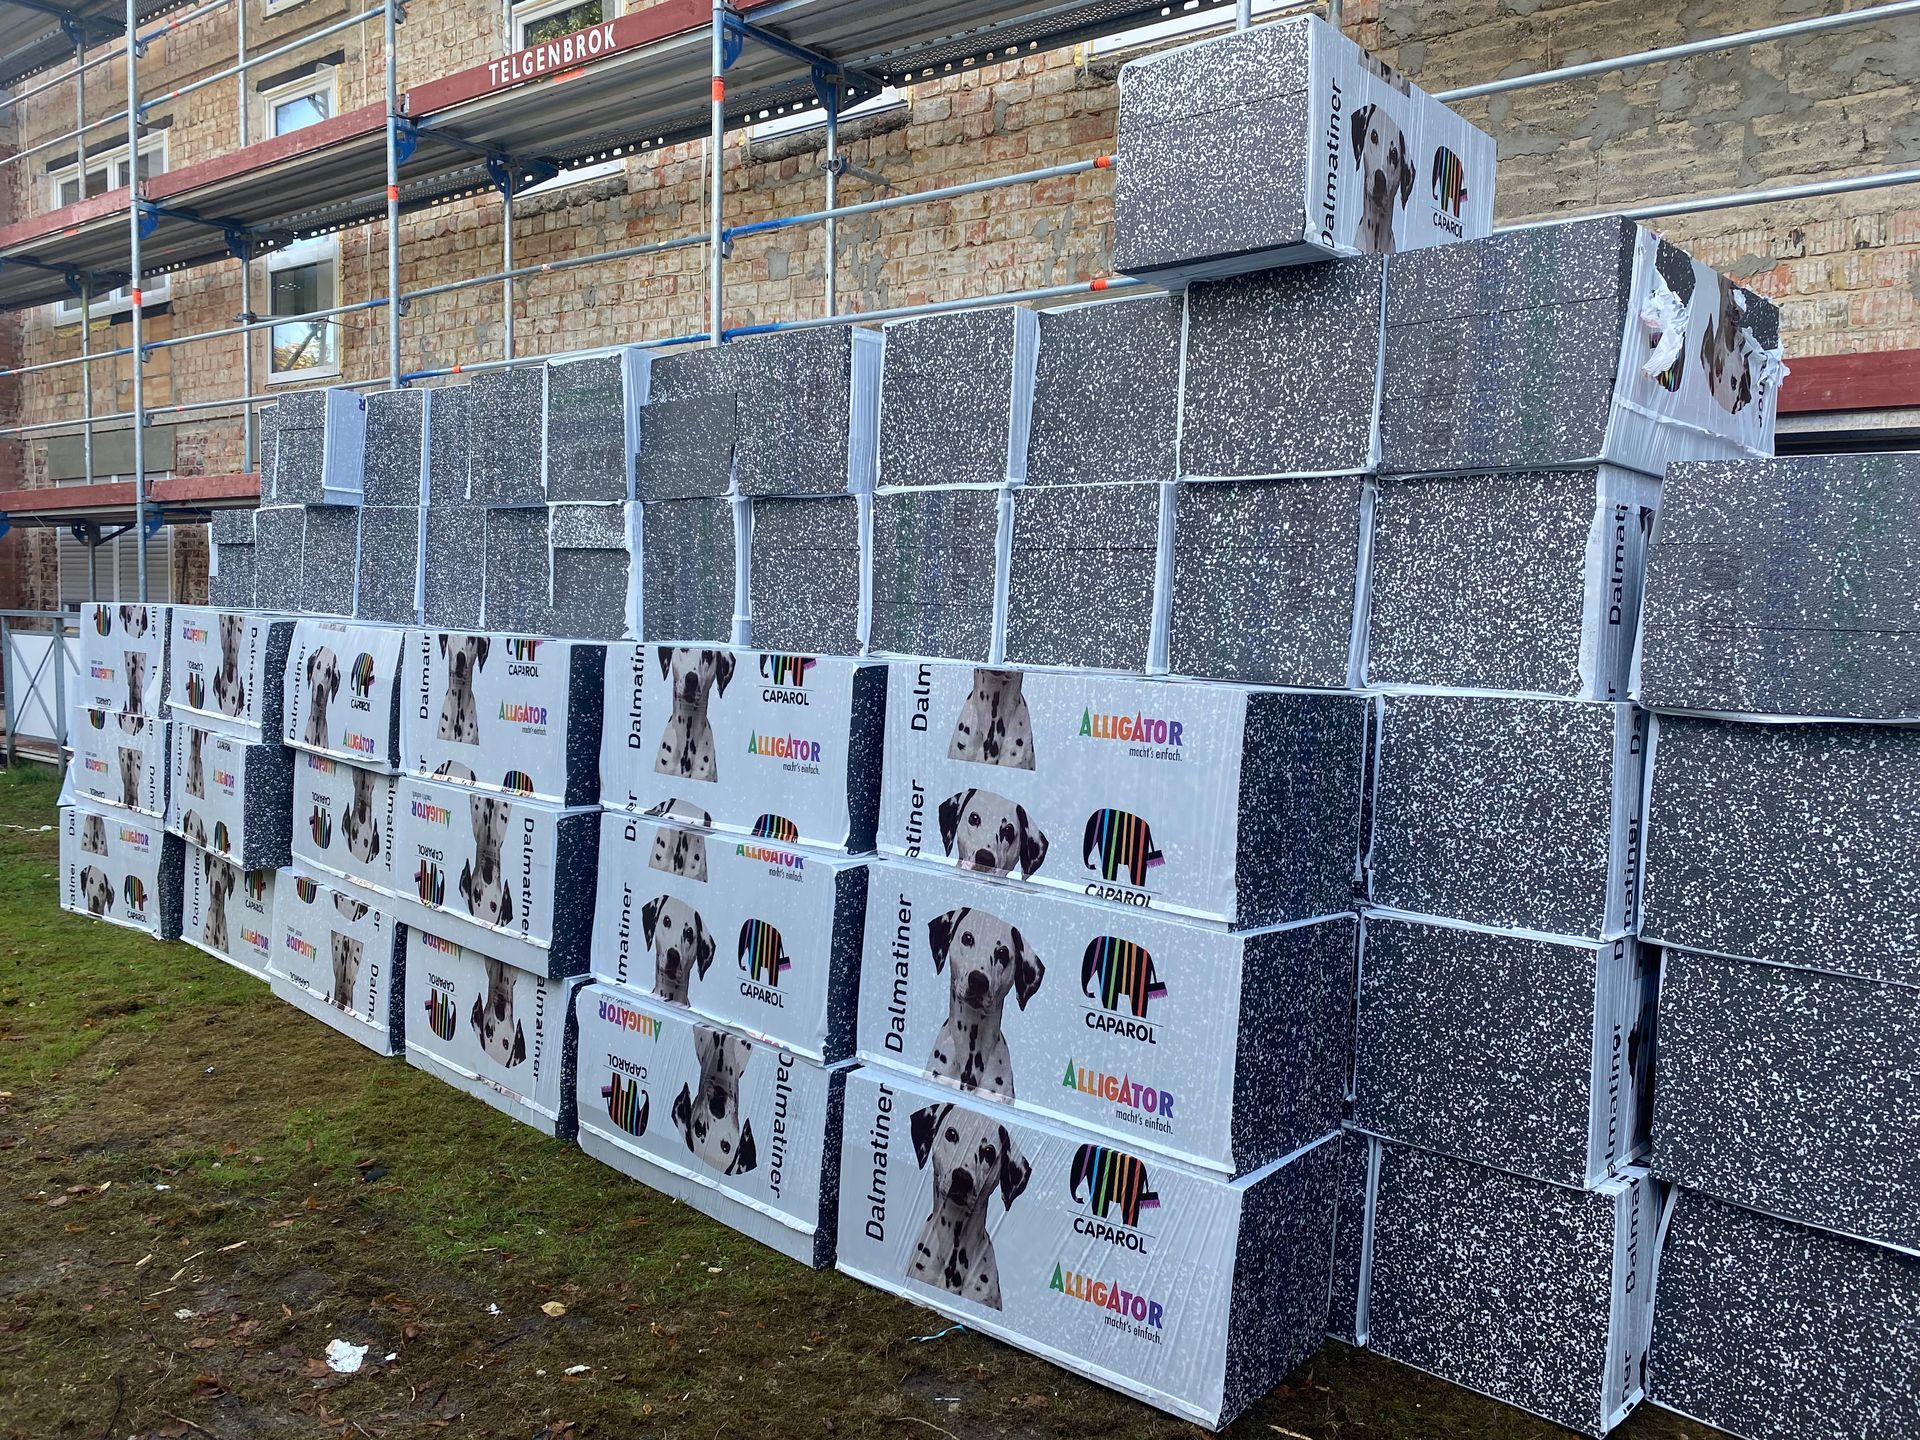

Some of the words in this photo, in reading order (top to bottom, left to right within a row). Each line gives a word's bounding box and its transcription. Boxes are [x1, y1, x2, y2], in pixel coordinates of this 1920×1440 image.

[488, 23, 617, 86] TELGENBROK
[1321, 77, 1343, 249] Dalmatiner
[1609, 504, 1629, 626] Dalmati
[289, 642, 307, 741] Dalmatiner
[508, 664, 539, 677] CAPAROL
[499, 698, 547, 725] ALLIGATOR
[628, 644, 645, 750] Dalmatin
[762, 689, 810, 706] CAPAROL
[343, 728, 375, 755] ALLIGATOR
[747, 728, 821, 763] ALLIGATOR
[1079, 706, 1184, 746] ALLIGATOR
[385, 777, 396, 872] almatiner
[411, 800, 452, 830] ALLIGATOR
[905, 779, 925, 858] atiner
[192, 848, 200, 926] Dalmatine
[1085, 883, 1153, 909] CAPAROL
[240, 924, 269, 950] ALLIGATOR
[615, 882, 633, 985] lmatiner
[428, 972, 455, 993] CAPAROL
[885, 893, 914, 1053] Dalmatiner
[740, 982, 784, 1009] CAPAROL
[533, 977, 547, 1082] almatiner
[599, 1000, 662, 1044] ALLIGATOR
[1085, 1012, 1157, 1044] CAPAROL
[607, 1053, 648, 1080] CAPAROL
[1062, 1056, 1174, 1118] ALLIGATOR
[1604, 1019, 1622, 1166] lmatiner
[770, 1052, 794, 1199] Dalmatiner
[1115, 1109, 1143, 1126] macht's
[1144, 1117, 1174, 1135] einfach.
[865, 1081, 894, 1242] Dalmatiner
[1073, 1217, 1148, 1255] CAPAROL
[1049, 1260, 1163, 1329] ALLIGATOR
[1104, 1315, 1132, 1333] macht's
[1133, 1326, 1162, 1345] einfach.
